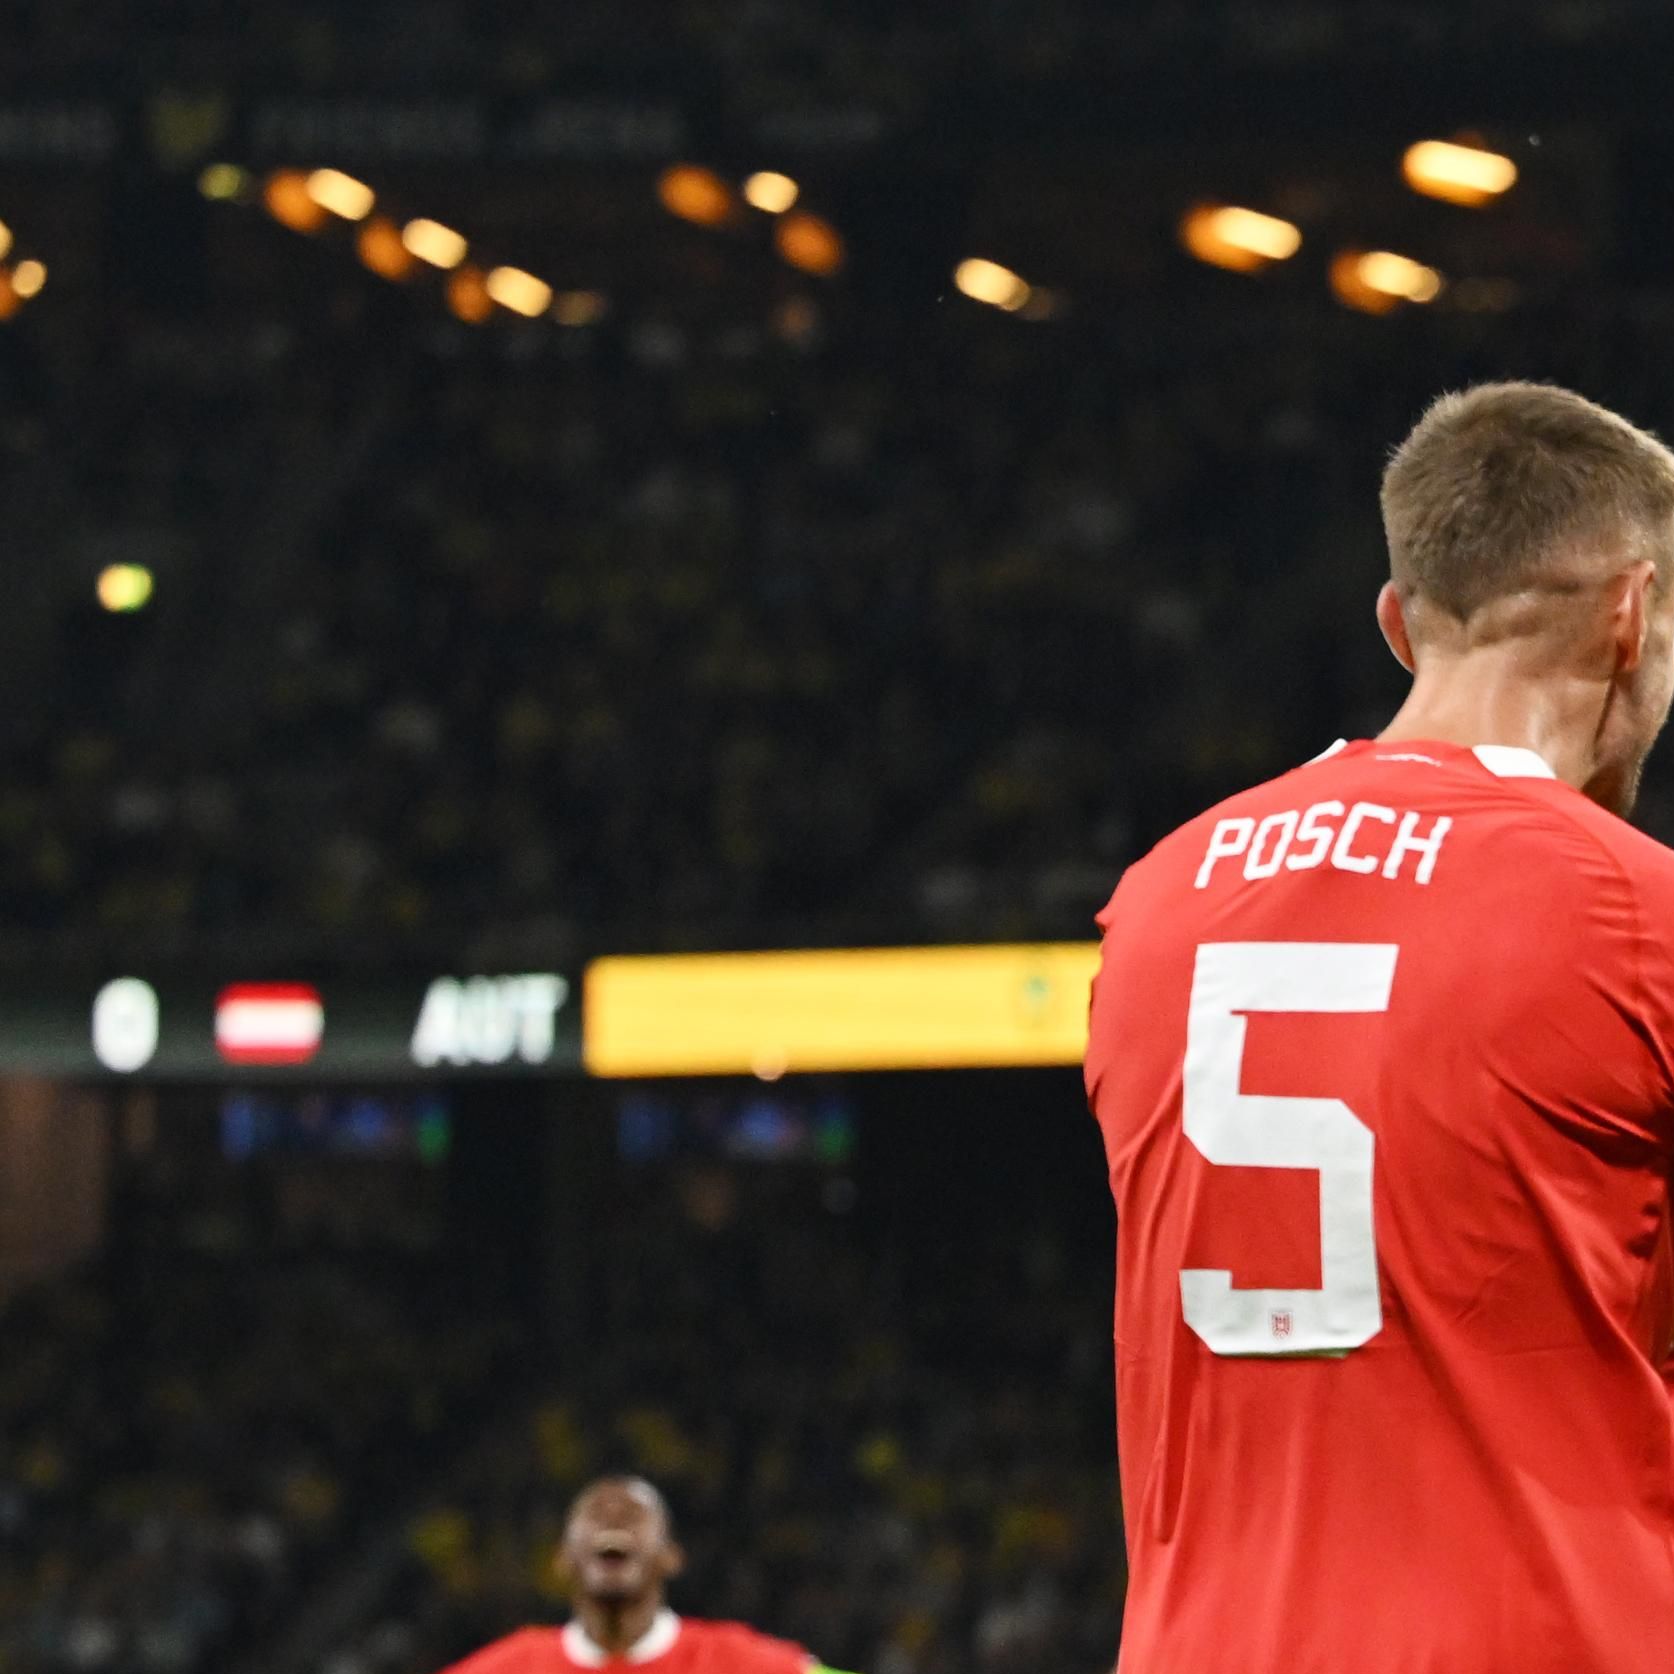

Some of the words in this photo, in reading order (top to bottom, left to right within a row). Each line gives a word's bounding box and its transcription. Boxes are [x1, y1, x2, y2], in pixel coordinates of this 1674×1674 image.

[1194, 800, 1451, 889] POSCH
[93, 976, 159, 1073] 0
[1178, 941, 1398, 1357] 5
